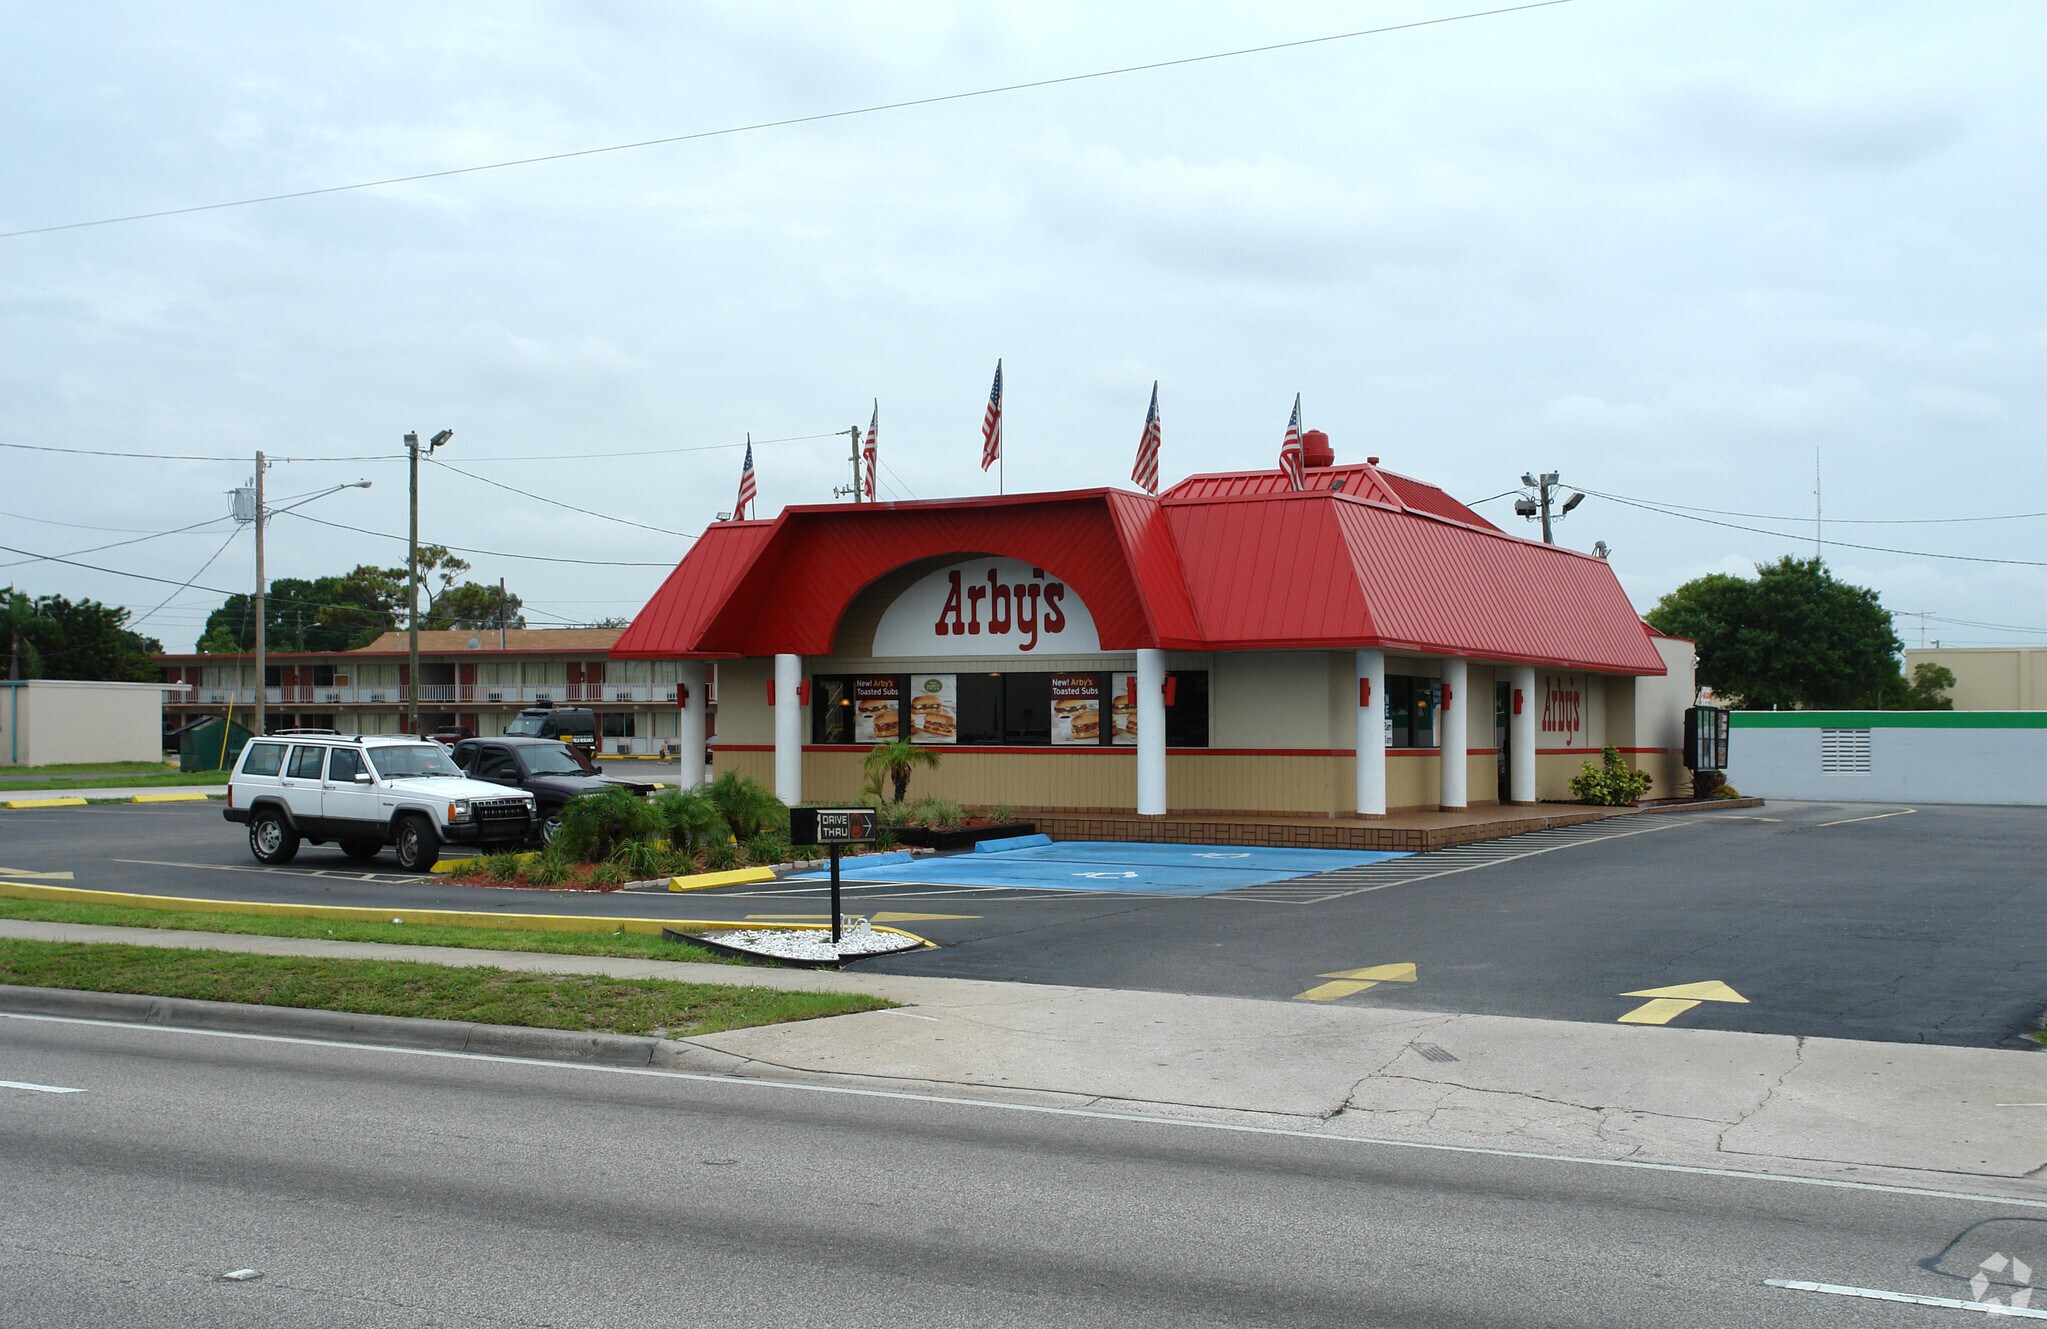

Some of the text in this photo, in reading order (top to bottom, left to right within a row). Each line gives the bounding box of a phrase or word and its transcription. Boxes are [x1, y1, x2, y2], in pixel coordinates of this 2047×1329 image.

[935, 568, 1065, 651] Arby's
[873, 679, 894, 689] Arby's
[1052, 678, 1093, 688] New! Arby's
[857, 688, 899, 696] Toasted Subs
[1052, 687, 1099, 695] Toasted Subs
[1542, 676, 1580, 746] Arby's
[822, 815, 848, 825] DRIVE
[822, 827, 848, 837] THRU
